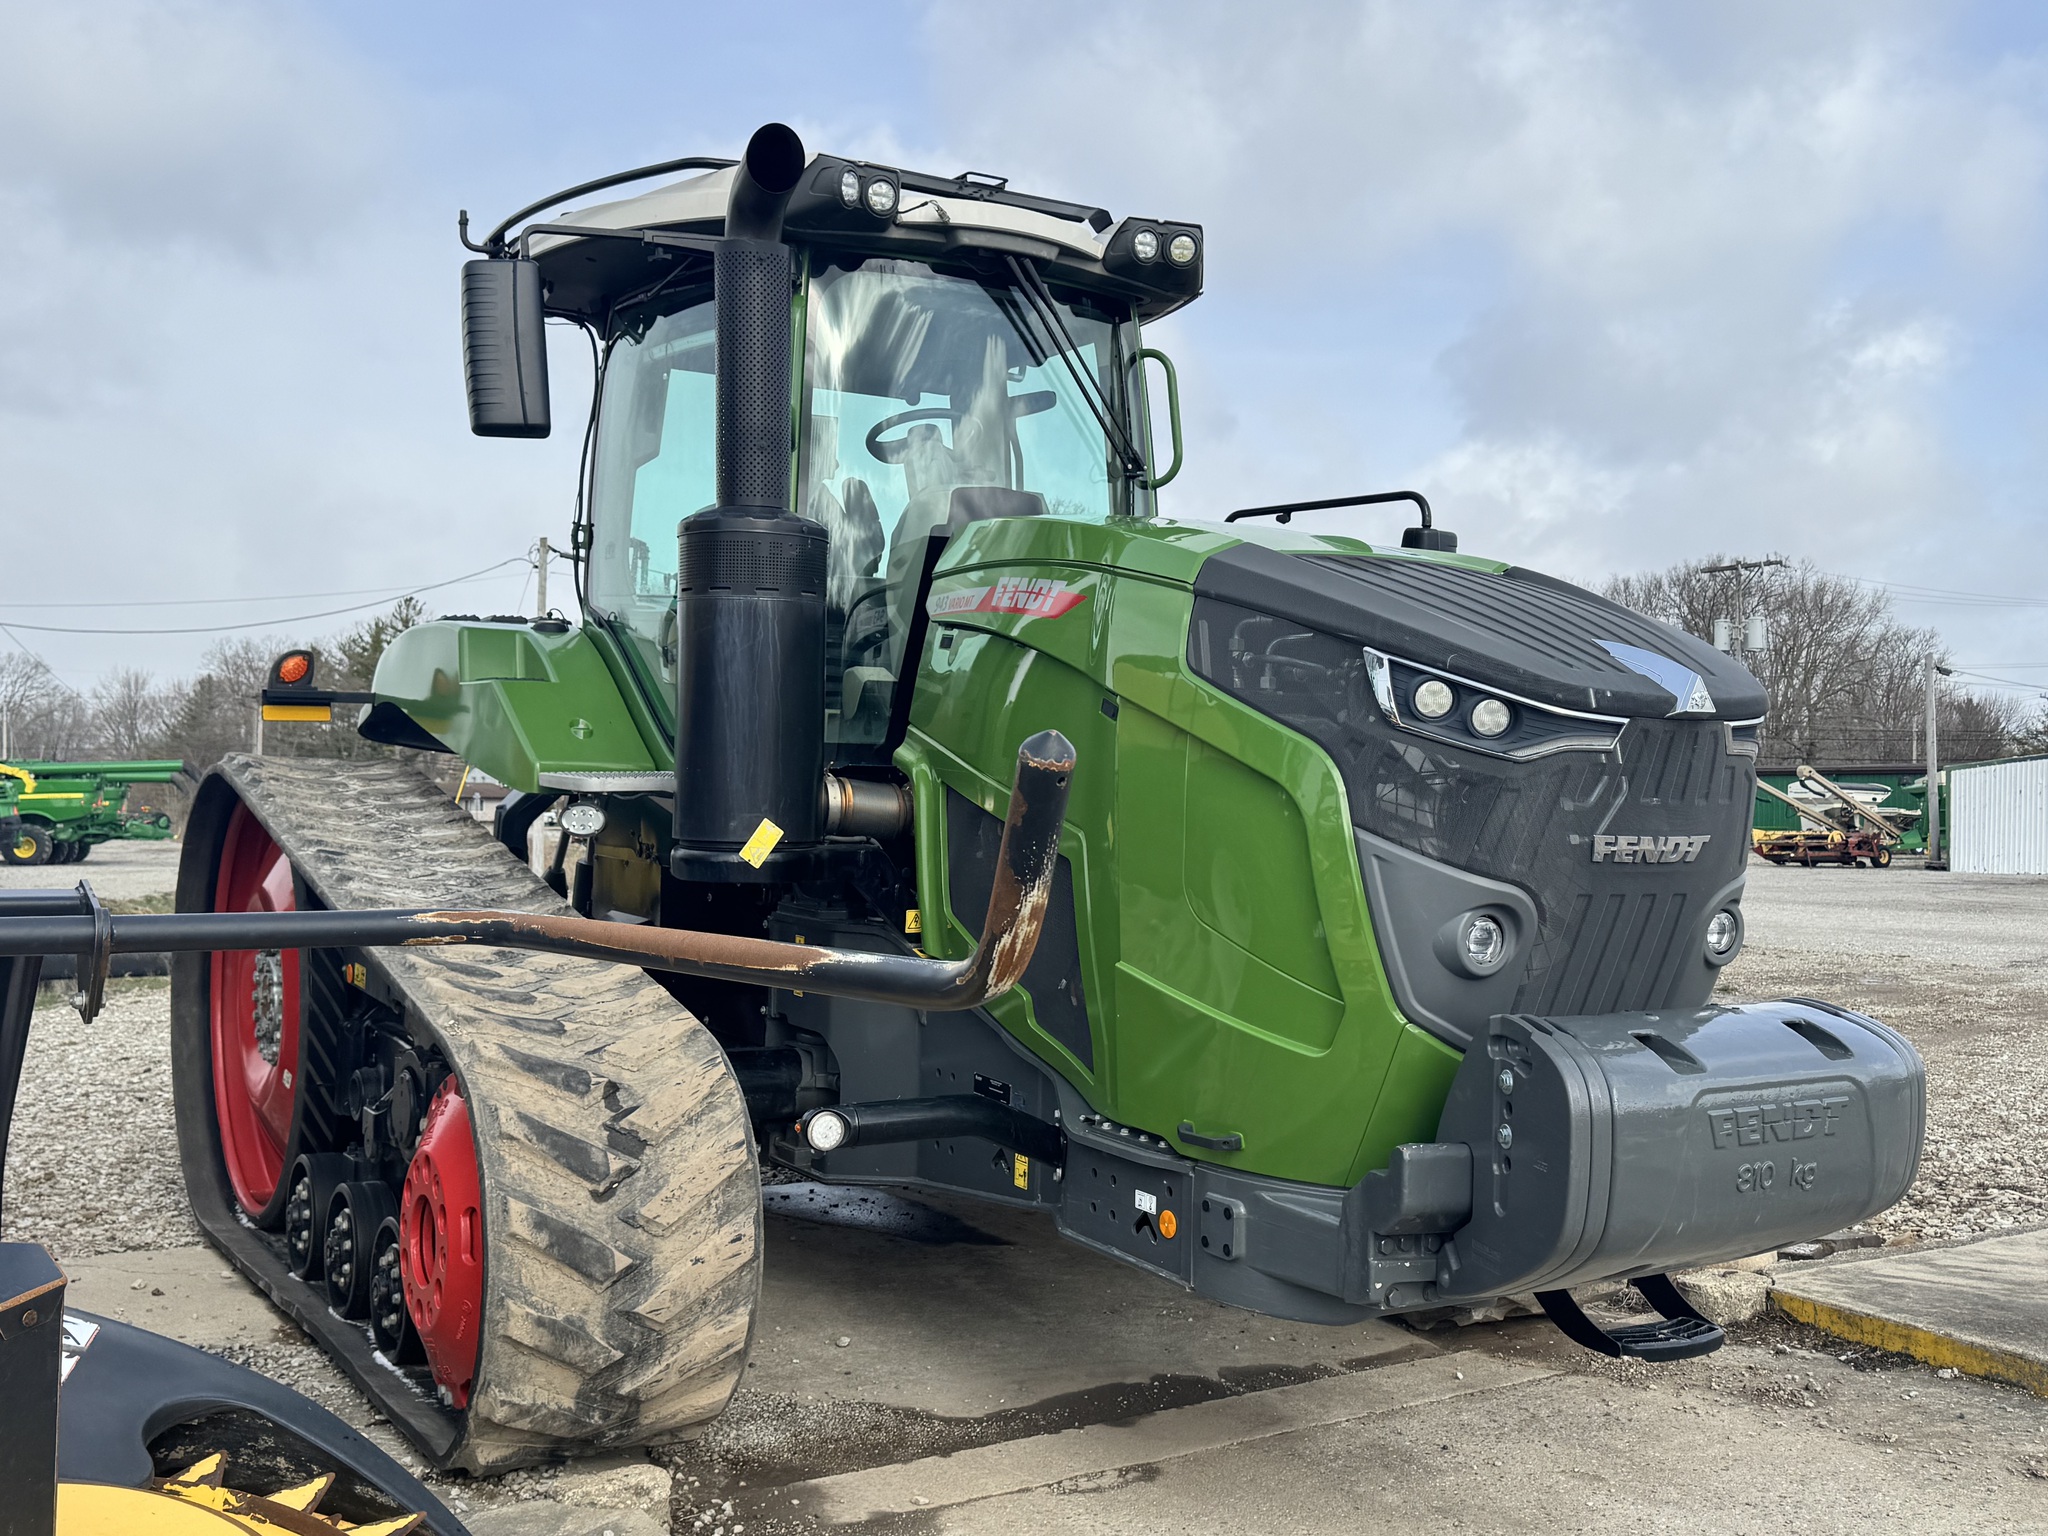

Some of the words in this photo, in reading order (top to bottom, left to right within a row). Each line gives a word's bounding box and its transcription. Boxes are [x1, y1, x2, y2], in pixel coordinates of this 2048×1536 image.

[934, 595, 950, 613] 943
[991, 576, 1068, 612] FENDT
[1592, 834, 1711, 863] FENDT
[1707, 1096, 1849, 1149] FENDT
[1736, 1161, 1775, 1193] 810
[1789, 1157, 1817, 1191] kg
